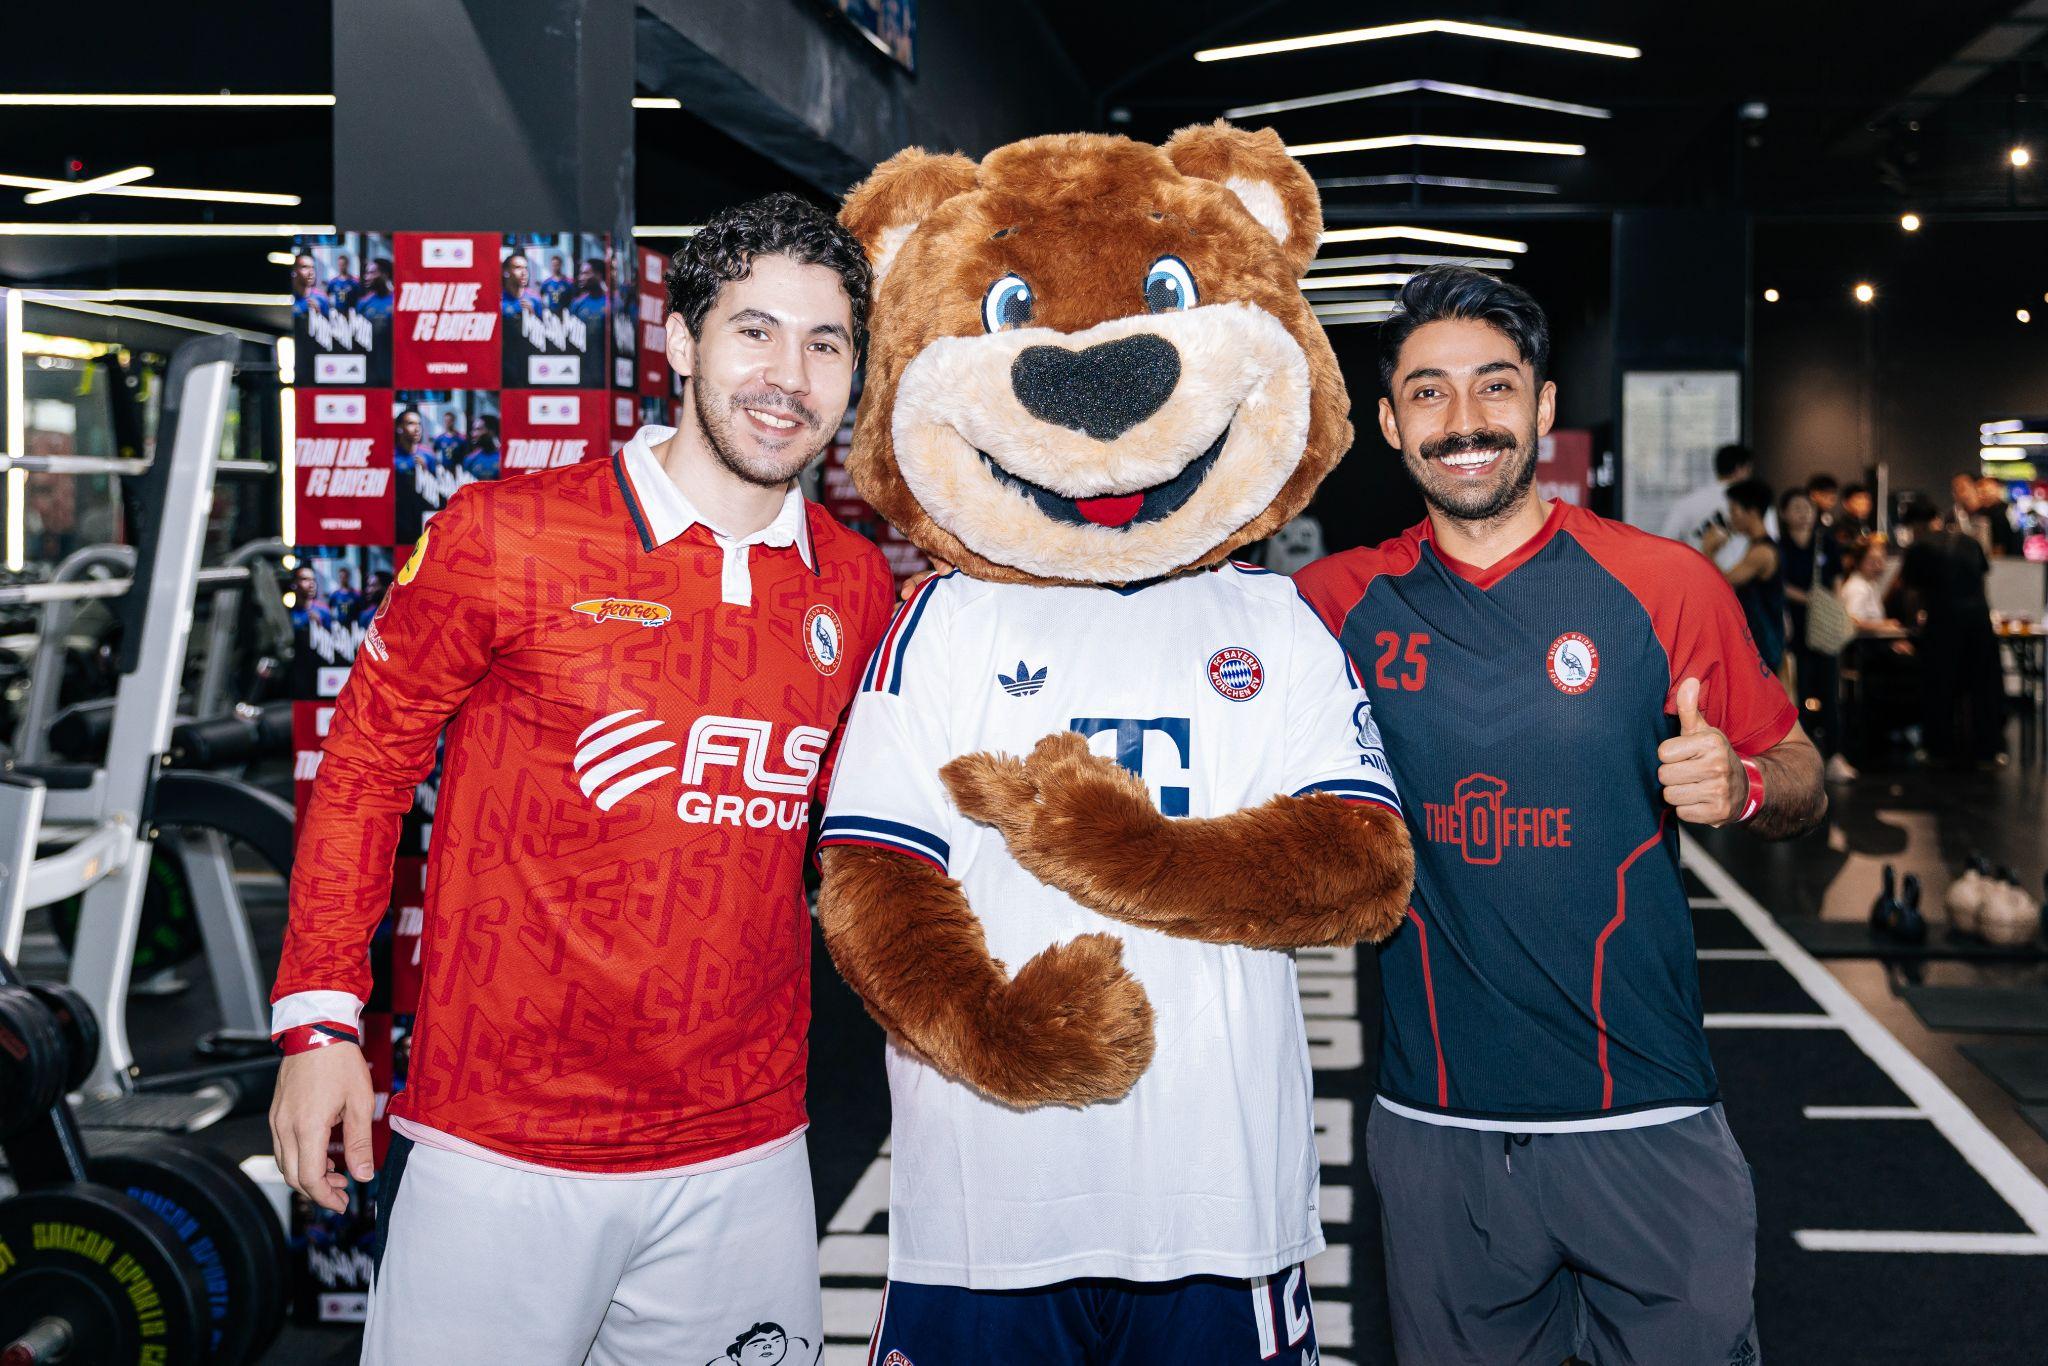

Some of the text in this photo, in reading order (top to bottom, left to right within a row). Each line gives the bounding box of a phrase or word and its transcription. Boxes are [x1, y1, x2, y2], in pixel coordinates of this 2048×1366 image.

[442, 282, 481, 311] LIKE
[412, 312, 439, 341] FC
[336, 438, 375, 467] LIKE
[305, 468, 331, 497] FC
[805, 607, 821, 632] SAIGON
[1224, 650, 1259, 671] BAYERN
[1375, 630, 1431, 691] 25
[1548, 634, 1597, 660] SAIGON RAIDERS
[1548, 667, 1597, 693] FOOTBALL CLUB
[681, 715, 829, 796] FLS
[1423, 802, 1573, 847] THE OFFICE
